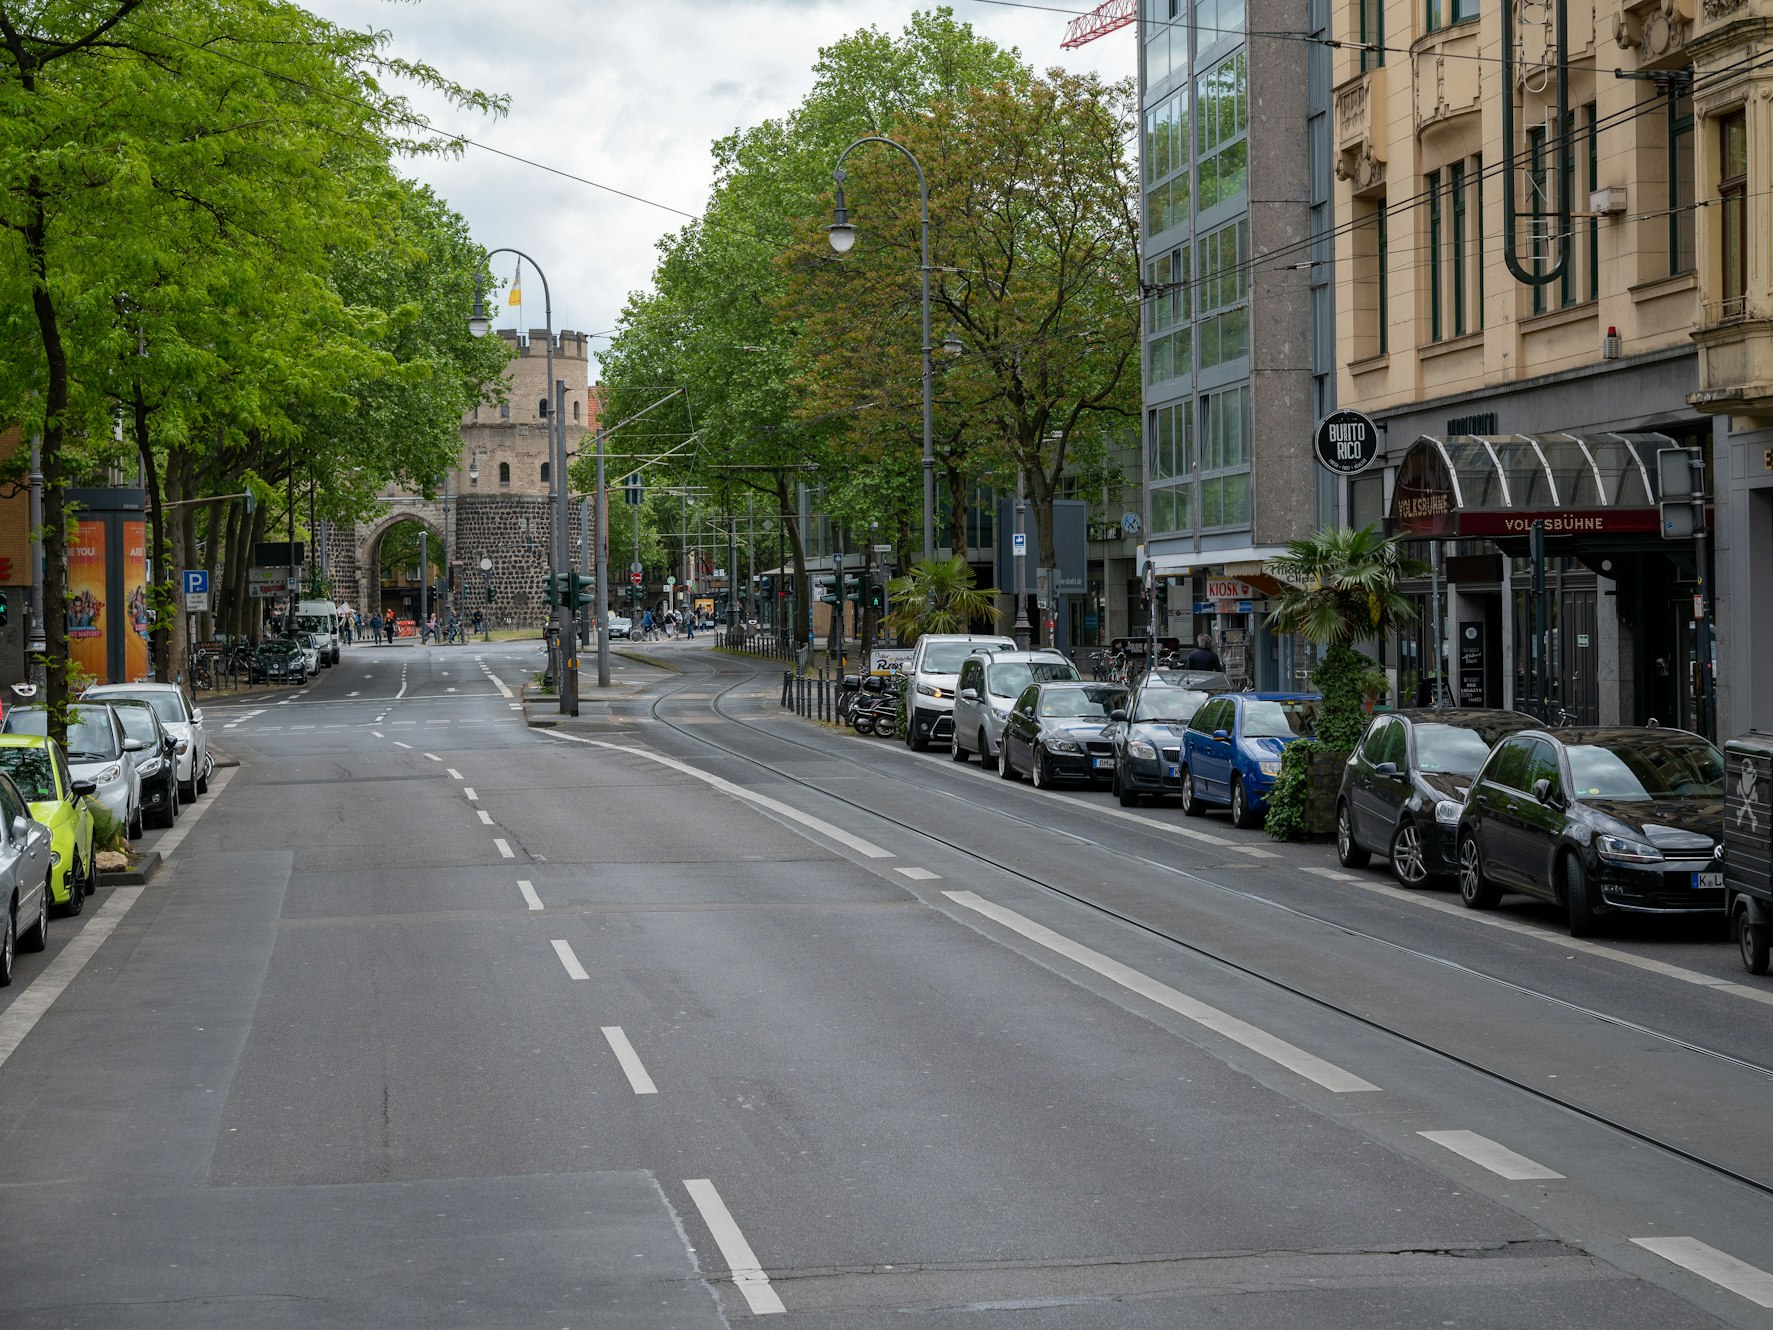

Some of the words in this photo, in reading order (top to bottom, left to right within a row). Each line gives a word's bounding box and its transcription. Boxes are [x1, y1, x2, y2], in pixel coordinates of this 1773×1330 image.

[1337, 441, 1361, 460] RICO
[1398, 489, 1447, 517] VOLKSBÜHNE
[1505, 514, 1603, 530] VOLSBÜHNE
[77, 547, 95, 556] YOU
[189, 574, 202, 592] P
[1286, 575, 1316, 585] Clips
[1209, 582, 1239, 597] KIOSK
[1699, 874, 1707, 887] K
[1714, 874, 1722, 886] L
